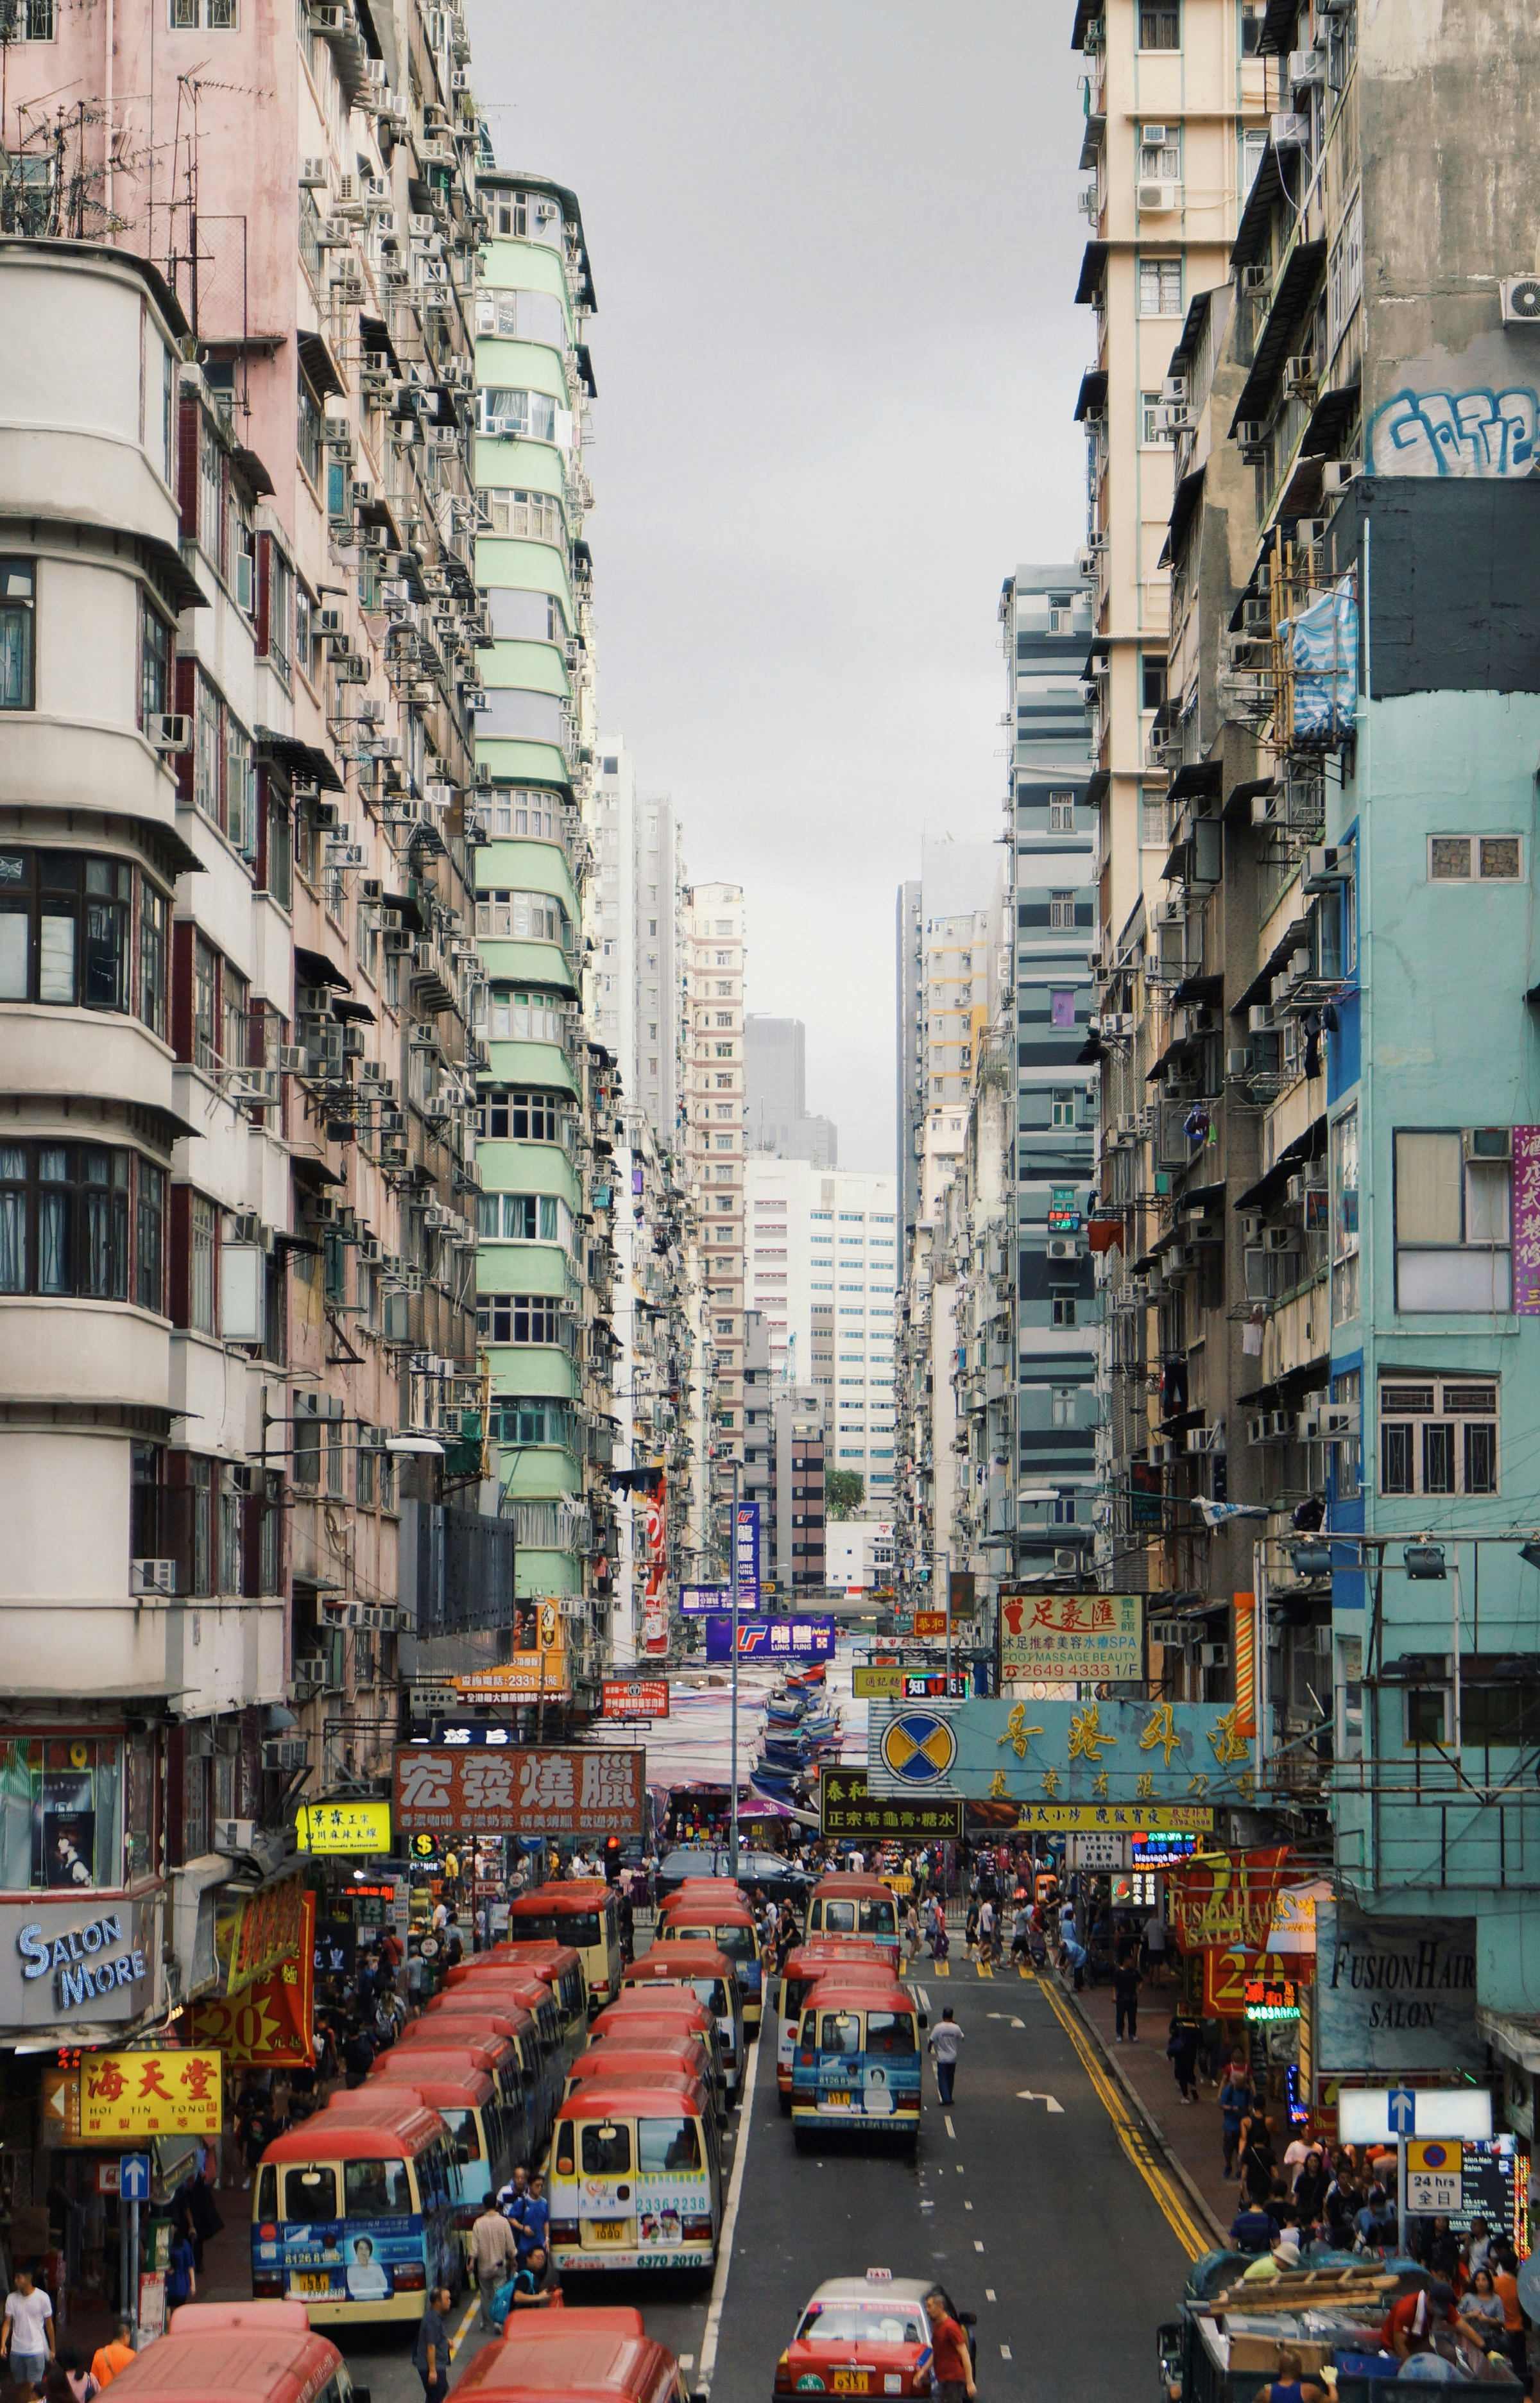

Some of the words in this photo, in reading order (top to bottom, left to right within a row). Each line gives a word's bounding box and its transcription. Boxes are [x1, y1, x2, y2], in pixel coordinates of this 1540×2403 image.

[1027, 1598, 1116, 1633] 足豪匯
[771, 1625, 812, 1644] 龍豐
[812, 1625, 830, 1636] Mall
[1003, 1653, 1031, 1662] FOOT
[1036, 1652, 1089, 1662] MASSAGE
[1093, 1652, 1136, 1662] BEAUTY
[1022, 1664, 1063, 1676] 2649
[1068, 1664, 1110, 1676] 4333
[1115, 1664, 1138, 1676] 1/F
[399, 1753, 636, 1809] 宏發燒臘
[400, 1814, 453, 1828] 香濃咖啡
[461, 1814, 513, 1828] 香濃奶茶
[1135, 1853, 1168, 1863] Massage
[1369, 2001, 1437, 2028] SALON
[207, 2004, 262, 2049] 20
[88, 2057, 217, 2101] 海天堂
[90, 2106, 111, 2115] HOI
[131, 2106, 151, 2114] TIN
[171, 2105, 205, 2114] TONG
[1414, 2175, 1432, 2187] 24
[1435, 2176, 1455, 2187] hrs
[673, 2196, 705, 2210] 2238
[1418, 2190, 1450, 2206] 全日
